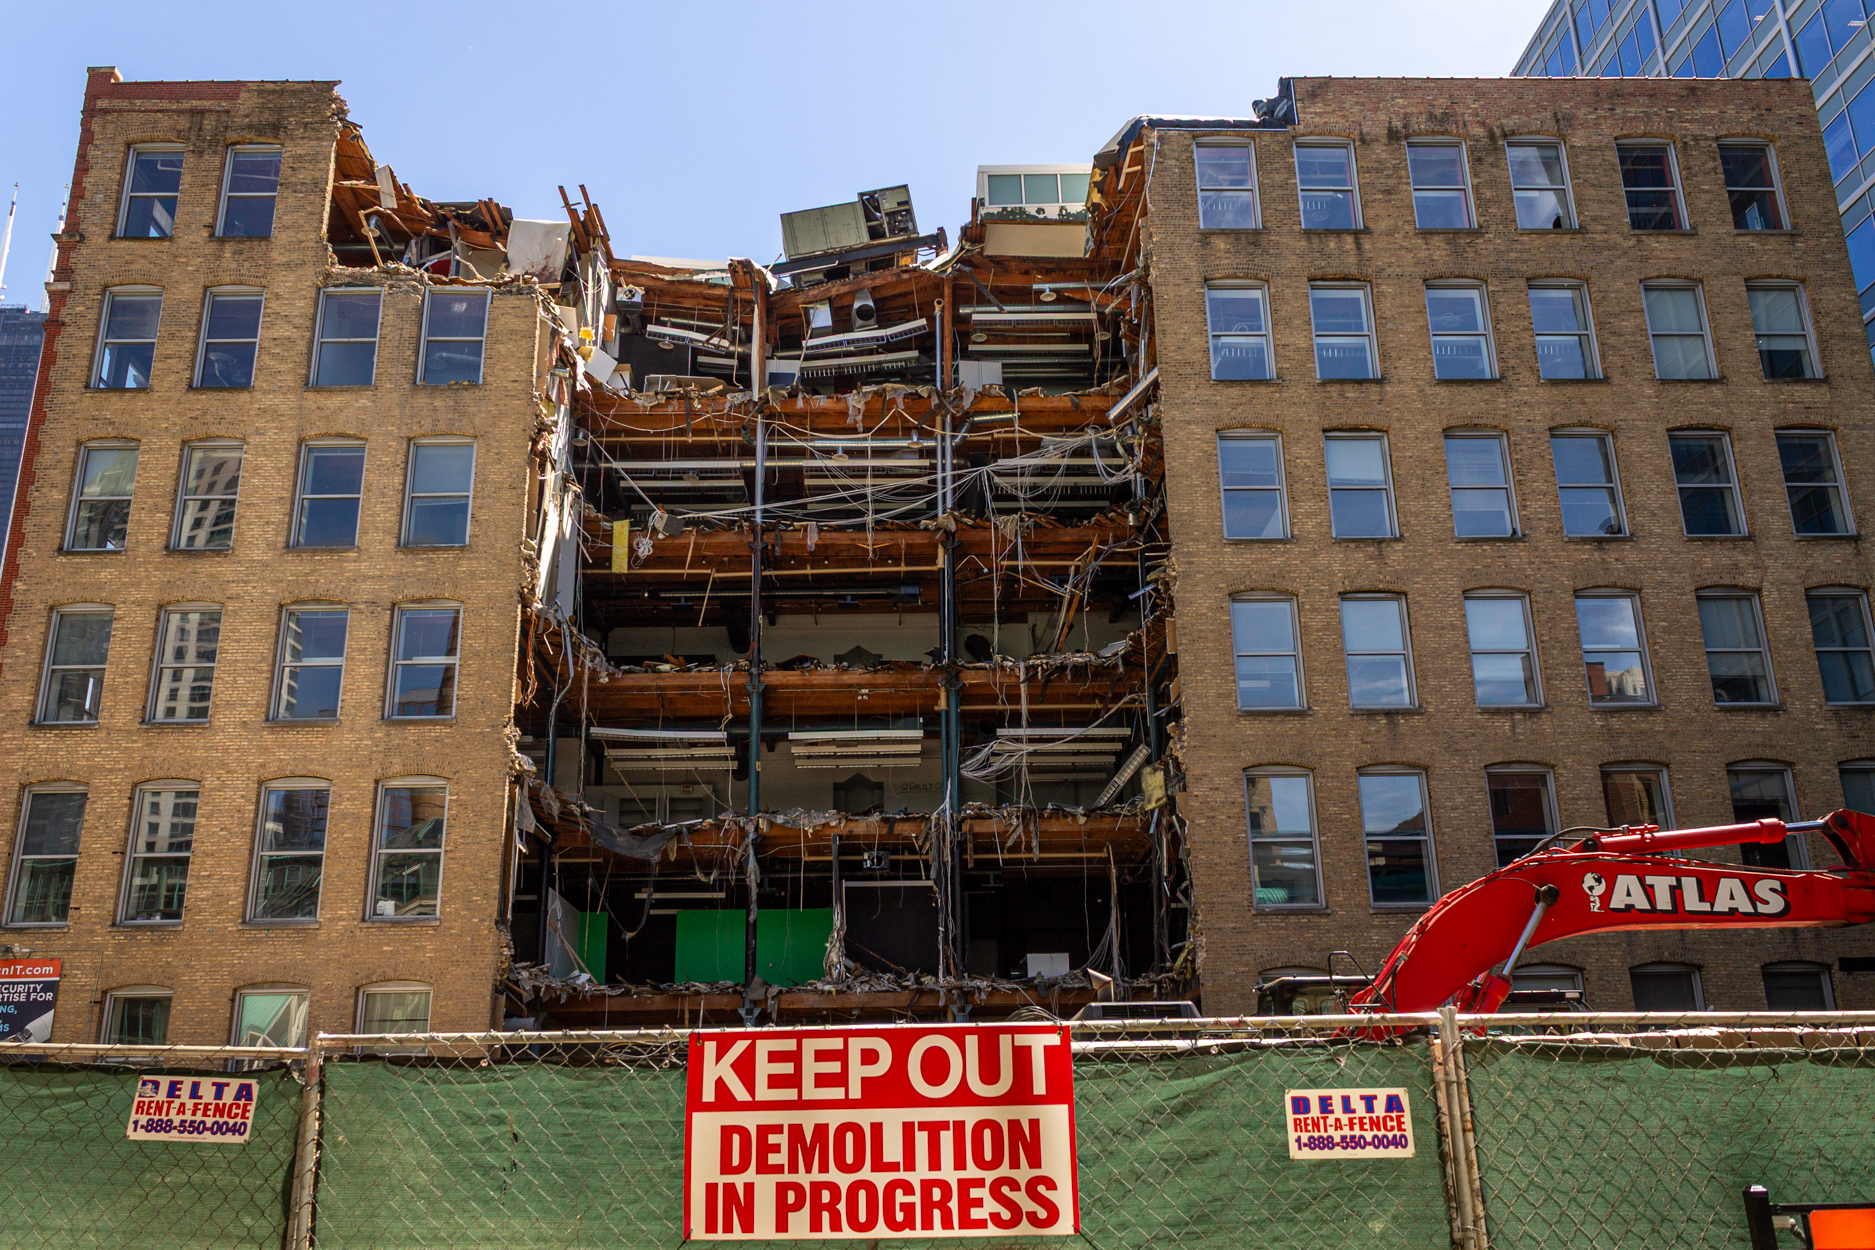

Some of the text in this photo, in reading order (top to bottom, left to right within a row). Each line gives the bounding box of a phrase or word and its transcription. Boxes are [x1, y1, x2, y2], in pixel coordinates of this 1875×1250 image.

[1609, 874, 1791, 918] ATLAS
[0, 965, 54, 976] nIT.com
[30, 992, 54, 1001] FOR
[702, 1033, 1061, 1103] KEEP OUT
[138, 1079, 254, 1102] DELTA
[134, 1100, 252, 1120] RENT-A-FENCE
[1290, 1094, 1406, 1116] DELTA
[132, 1118, 248, 1137] 1-888-550-0040
[1293, 1114, 1407, 1134] RENT-A-FENCE
[719, 1118, 1042, 1176] DEMOLITION
[1294, 1133, 1409, 1151] 1-888-550-0040
[704, 1175, 1061, 1234] IN PROGRESS
